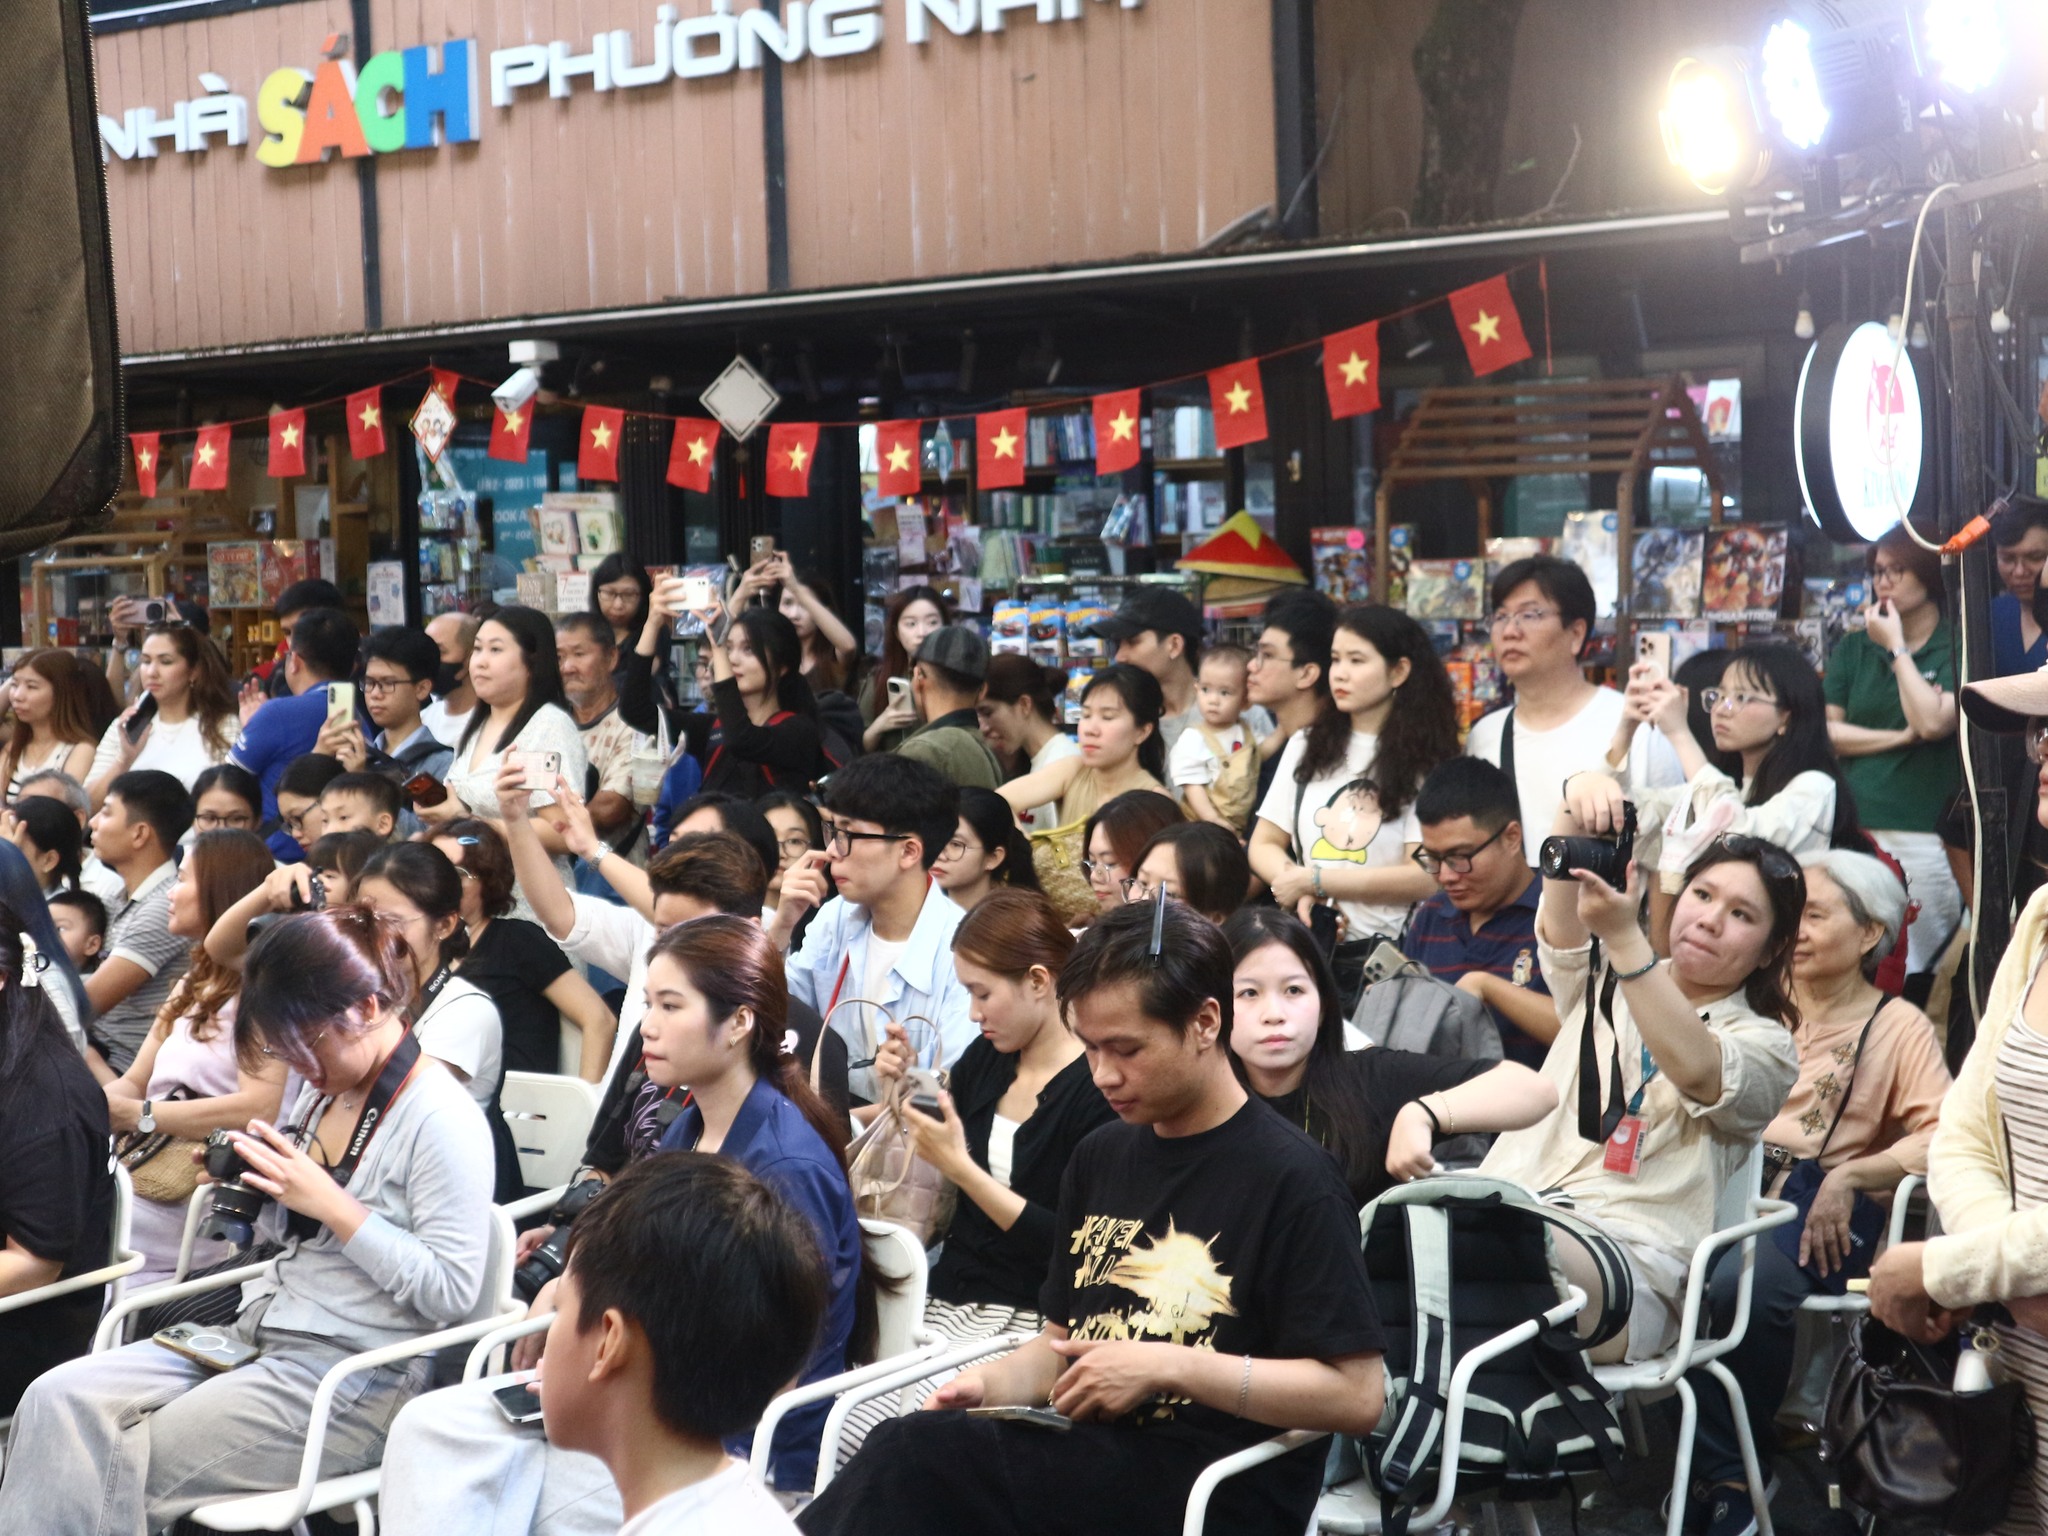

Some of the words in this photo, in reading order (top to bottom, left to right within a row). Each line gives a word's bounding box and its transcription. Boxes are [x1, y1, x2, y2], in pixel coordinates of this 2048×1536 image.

[98, 72, 248, 163] NHÀ
[255, 33, 479, 168] SÁCH
[490, 0, 882, 107] PHƯƠNG
[428, 968, 448, 993] SONY
[349, 1107, 379, 1157] Canon
